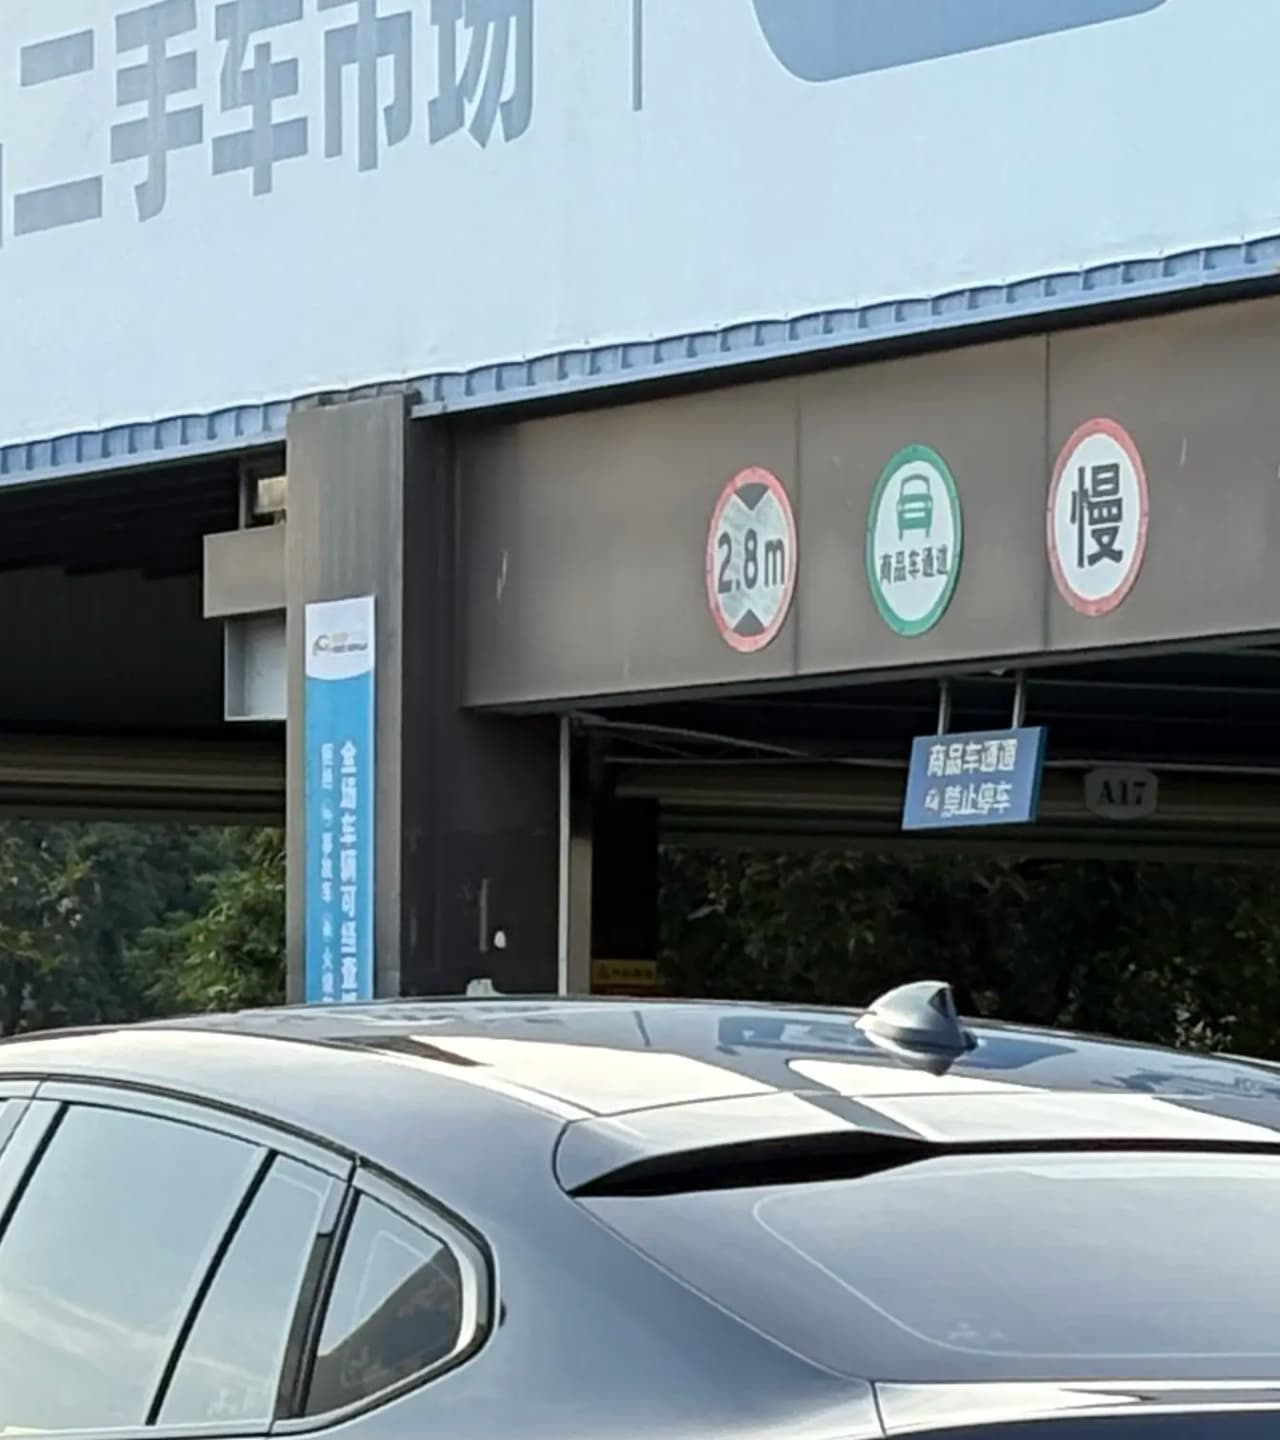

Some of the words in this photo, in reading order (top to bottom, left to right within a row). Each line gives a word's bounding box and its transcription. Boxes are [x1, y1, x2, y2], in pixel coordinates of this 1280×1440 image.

[1070, 462, 1124, 569] 慢
[718, 529, 785, 595] 2.8m
[879, 543, 950, 586] 商品车通道
[927, 738, 1018, 777] 商品车通道
